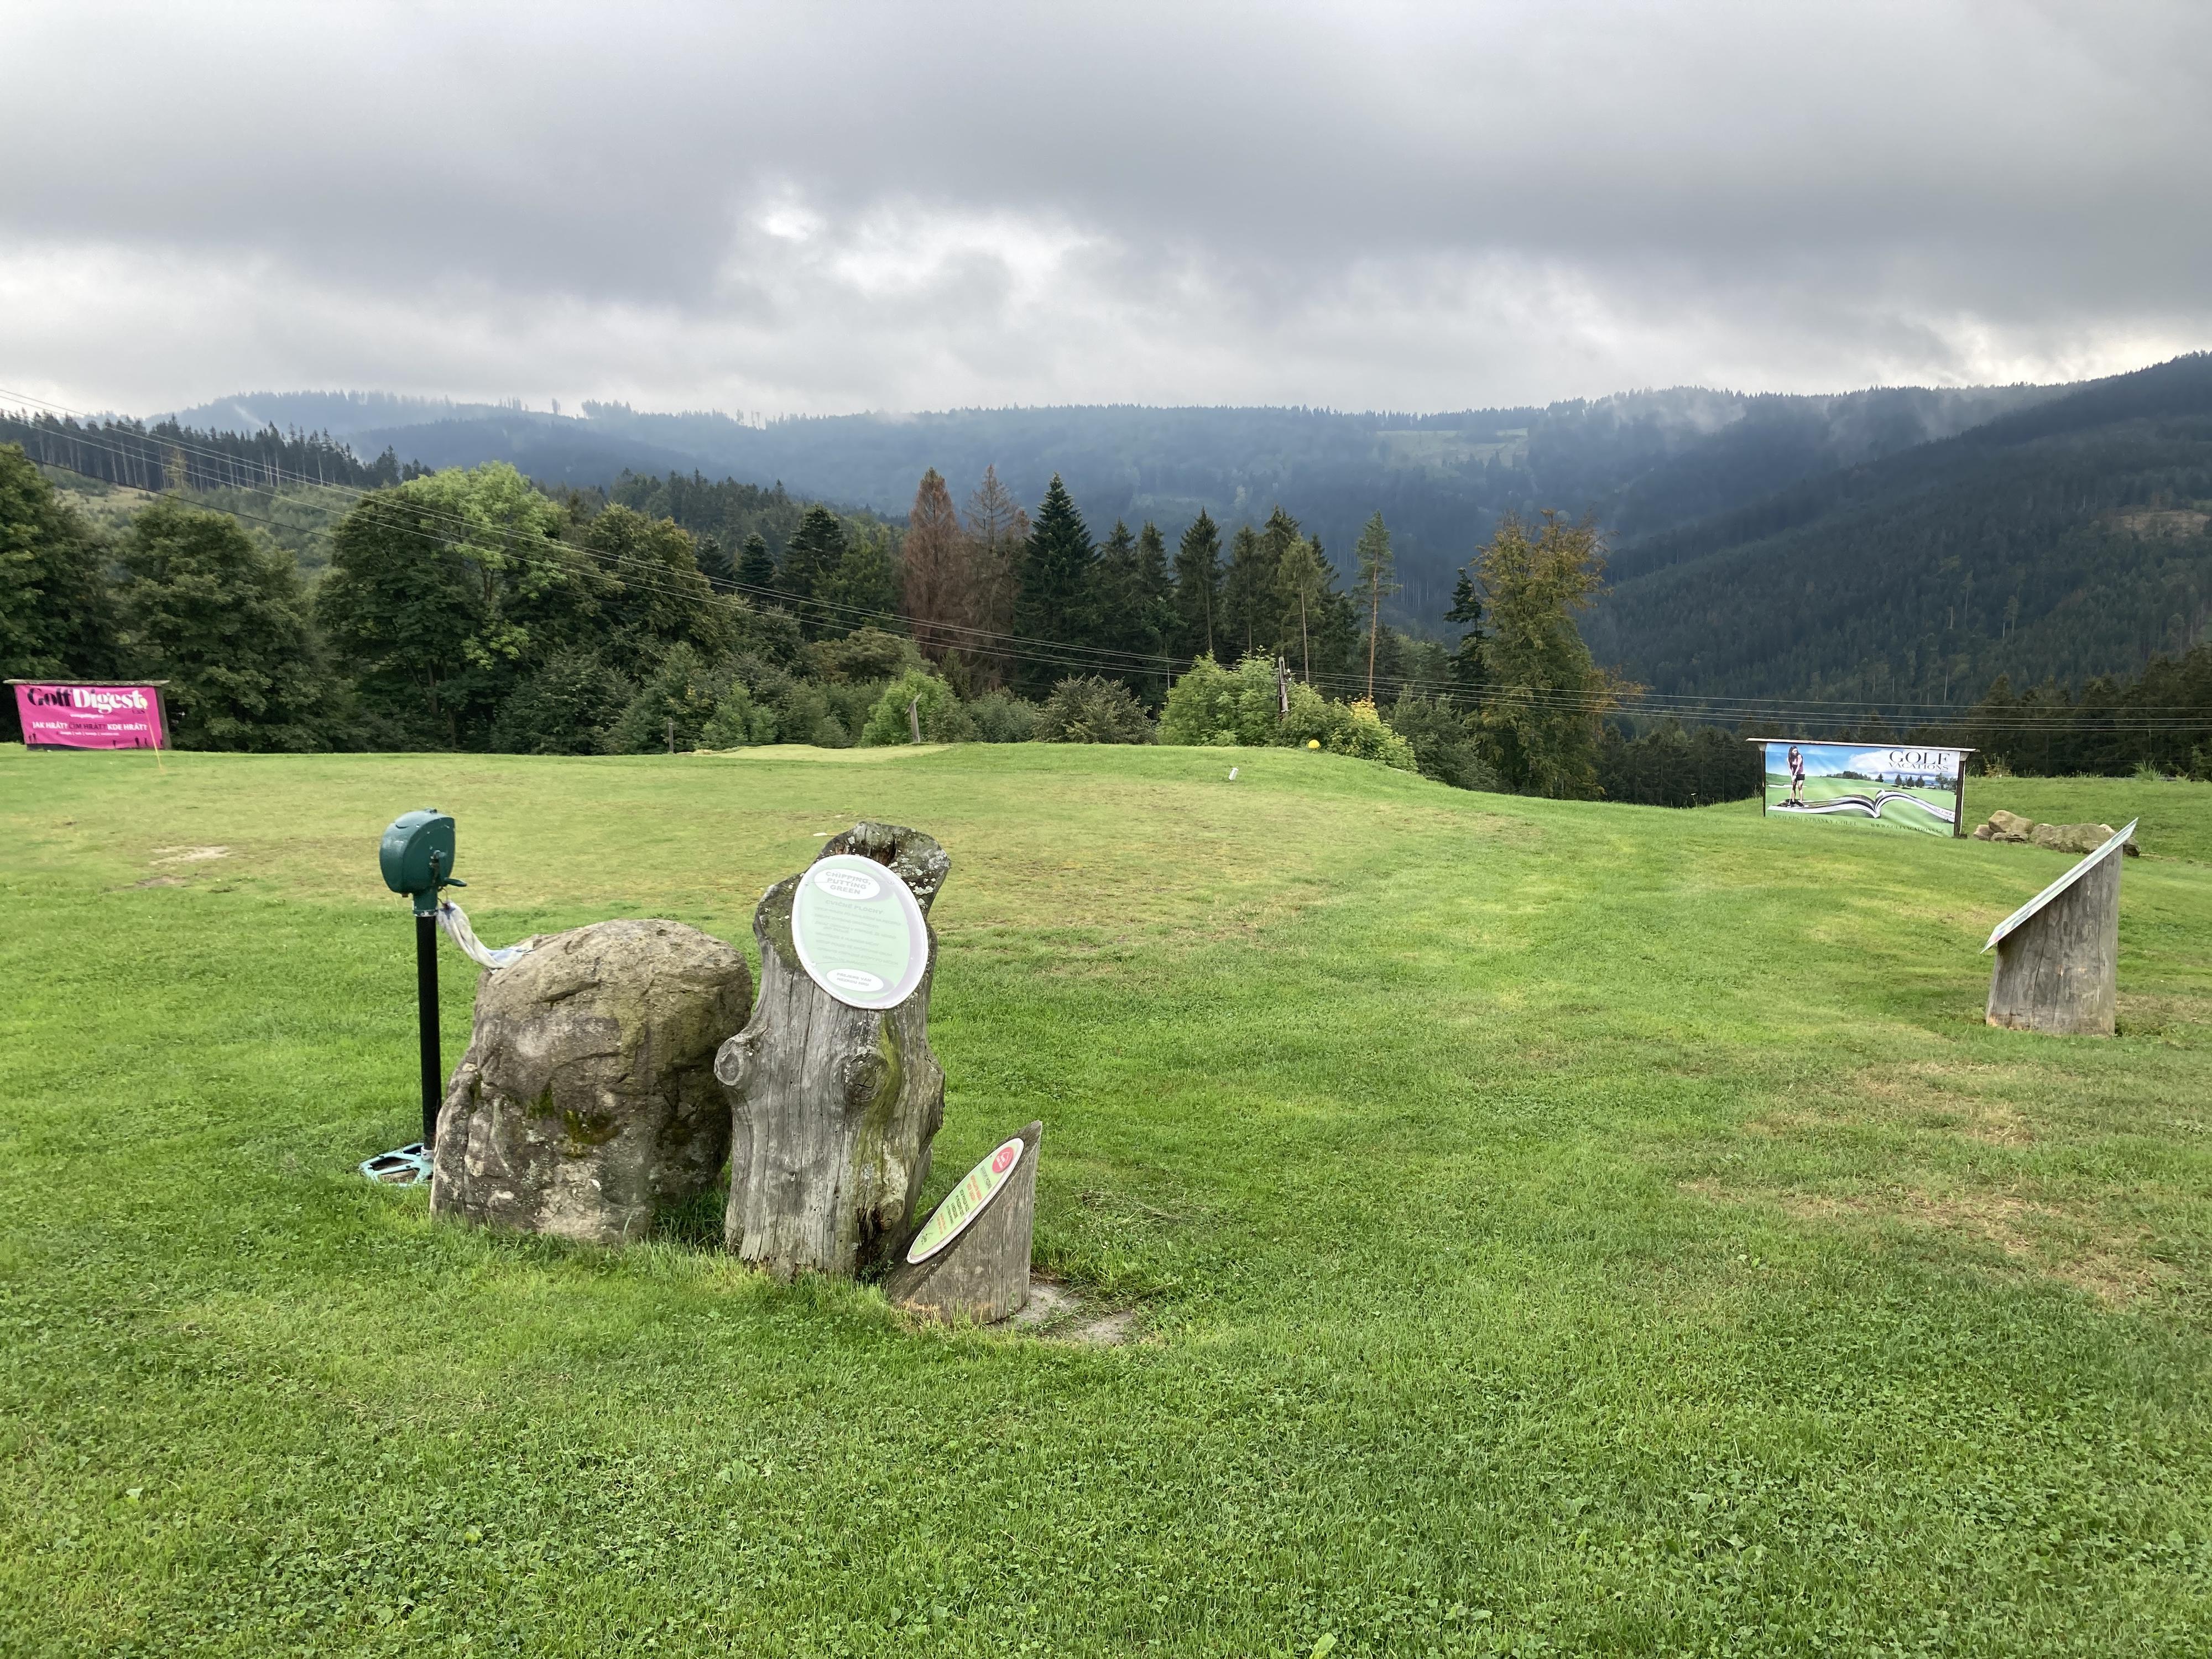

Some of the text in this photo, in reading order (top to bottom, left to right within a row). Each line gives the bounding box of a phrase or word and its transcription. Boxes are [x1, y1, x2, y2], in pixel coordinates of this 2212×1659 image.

[27, 688, 144, 714] Golf Digest
[1889, 750, 1950, 765] GOLF
[1889, 762, 1949, 770] VACATIONS
[825, 871, 871, 885] CHIPPING,
[827, 877, 867, 889] PUTTING
[830, 884, 860, 895] GREEN
[853, 905, 884, 915] PLOCHY
